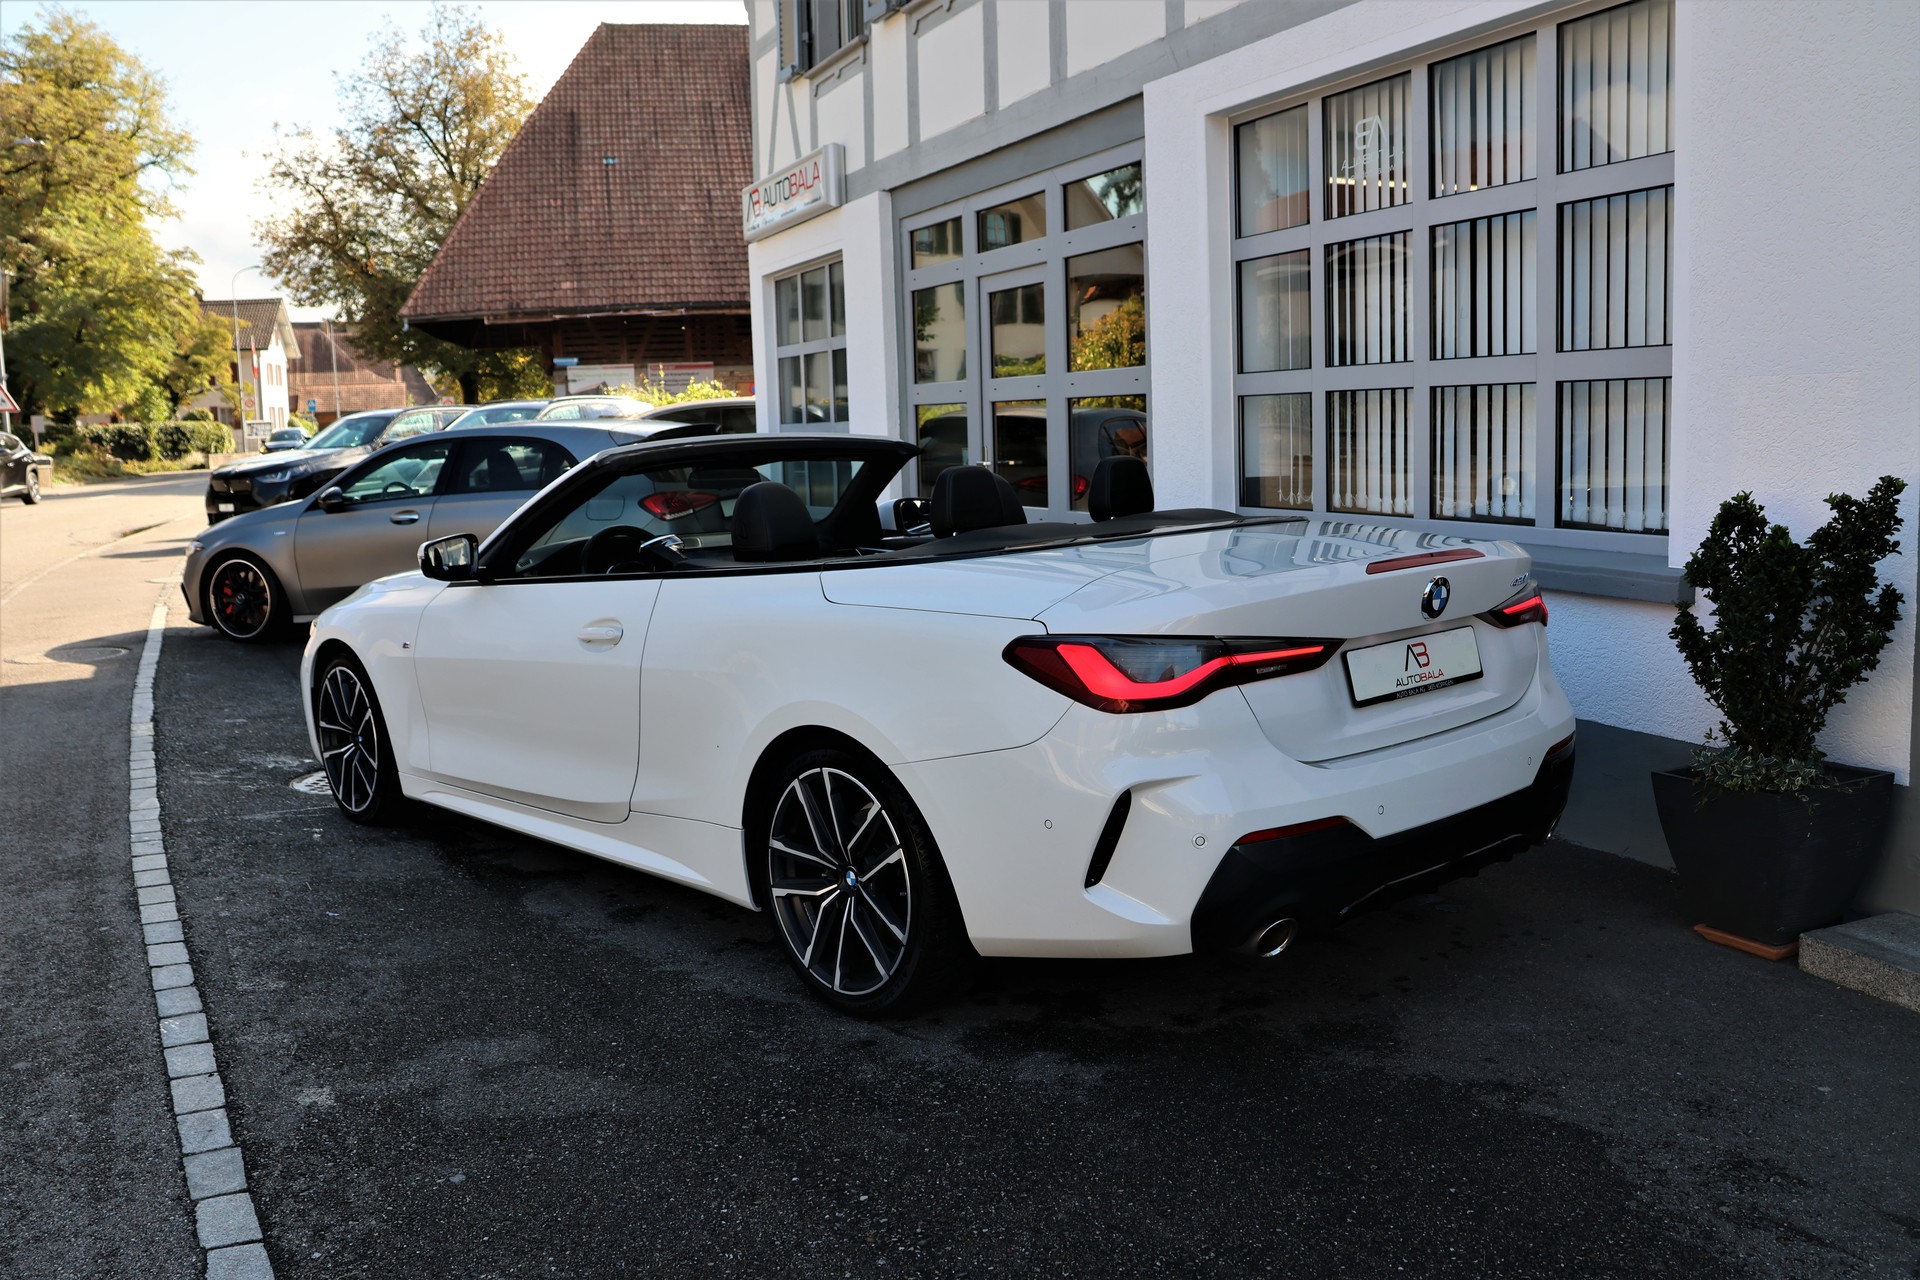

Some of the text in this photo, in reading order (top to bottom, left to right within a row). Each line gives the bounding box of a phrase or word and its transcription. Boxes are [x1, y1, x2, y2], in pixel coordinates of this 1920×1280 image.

[763, 161, 820, 207] AUTOBALA
[1404, 641, 1431, 672] AB
[1395, 668, 1445, 688] AUTOBALA
